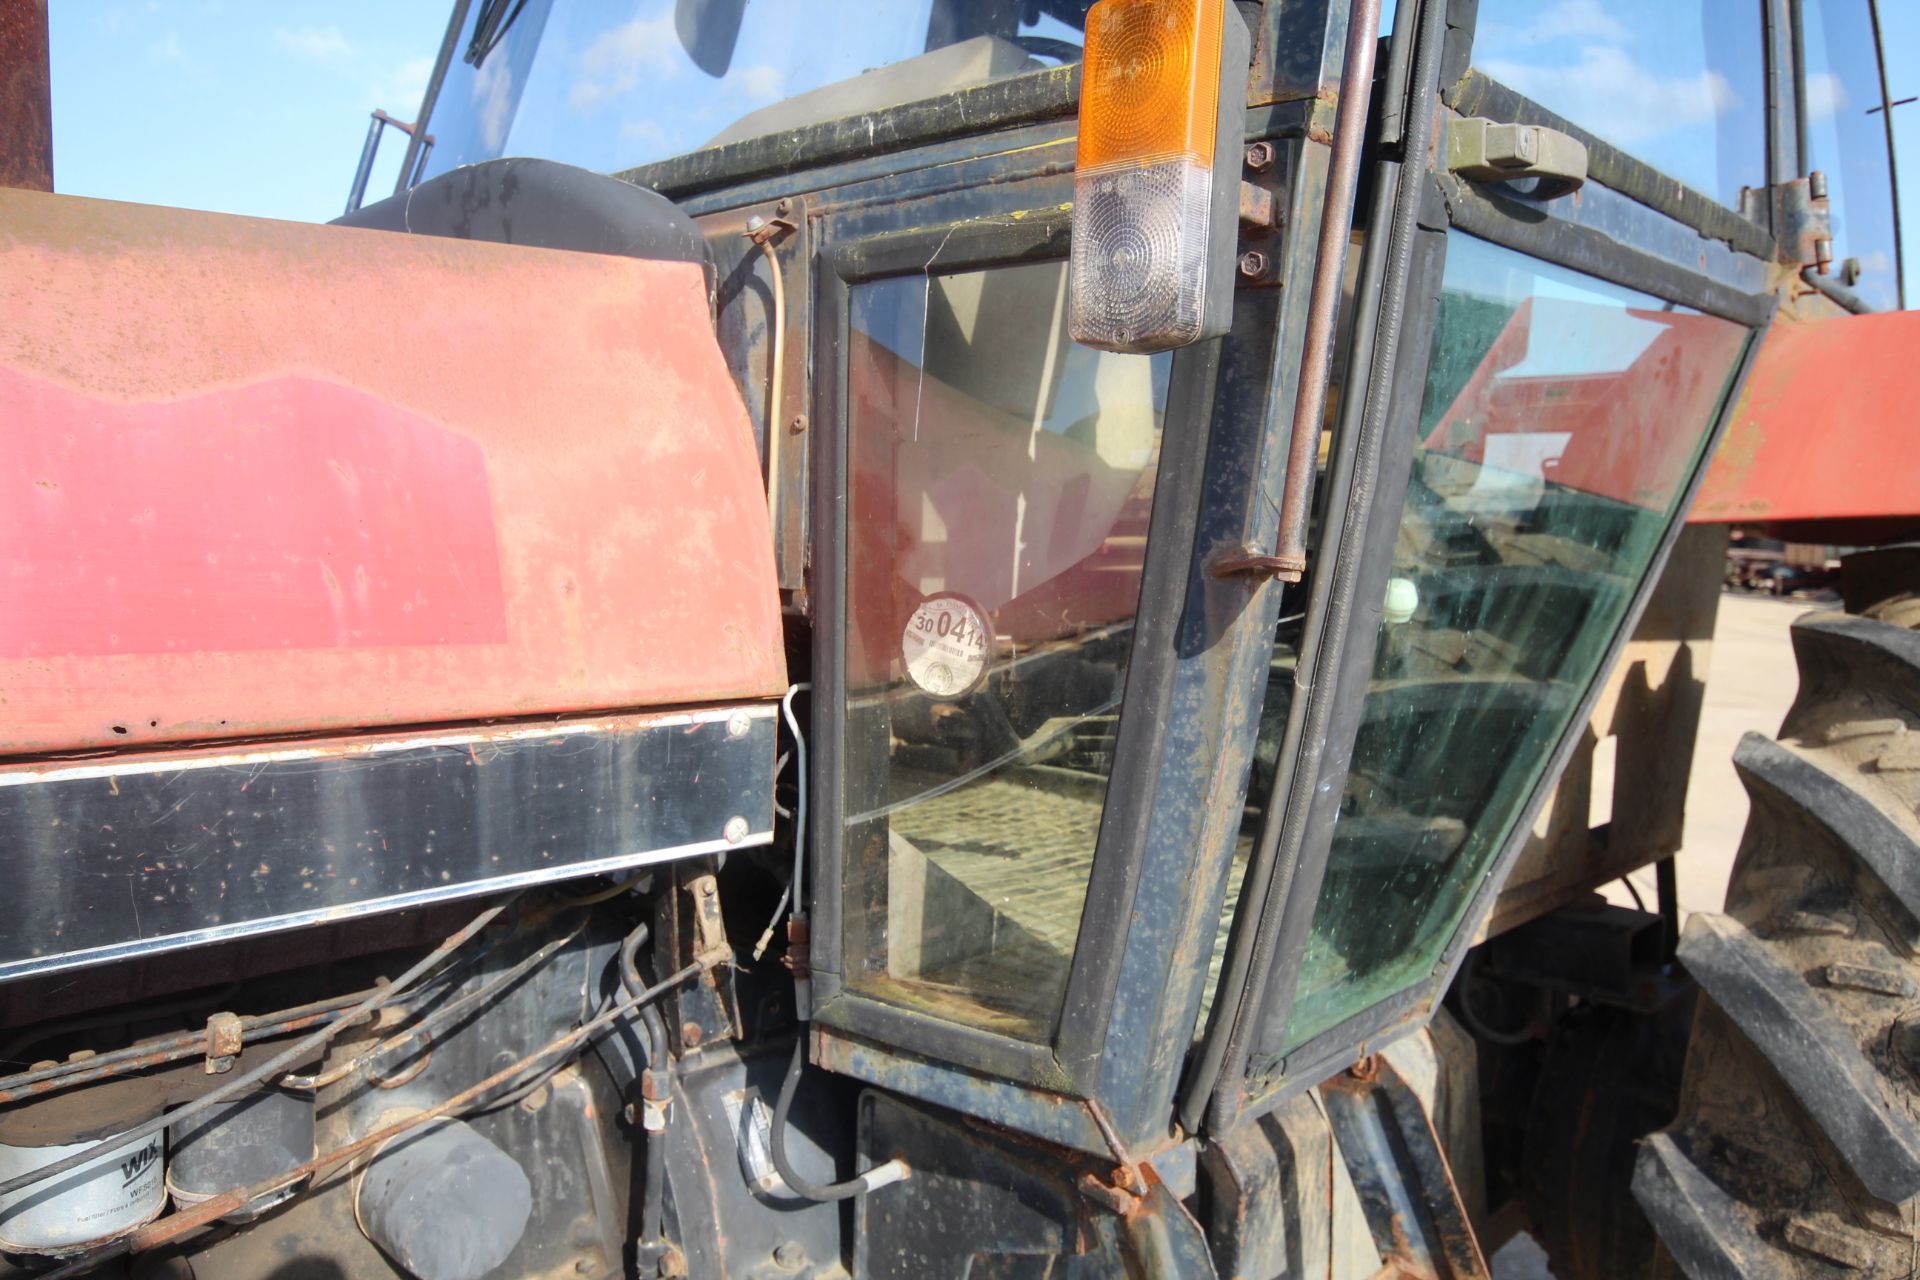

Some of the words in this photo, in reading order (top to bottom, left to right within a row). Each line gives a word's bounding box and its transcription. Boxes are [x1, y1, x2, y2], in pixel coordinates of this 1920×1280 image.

[915, 615, 934, 632] 30
[937, 611, 967, 643] 04
[967, 629, 984, 651] 14
[121, 1136, 158, 1180] WIX
